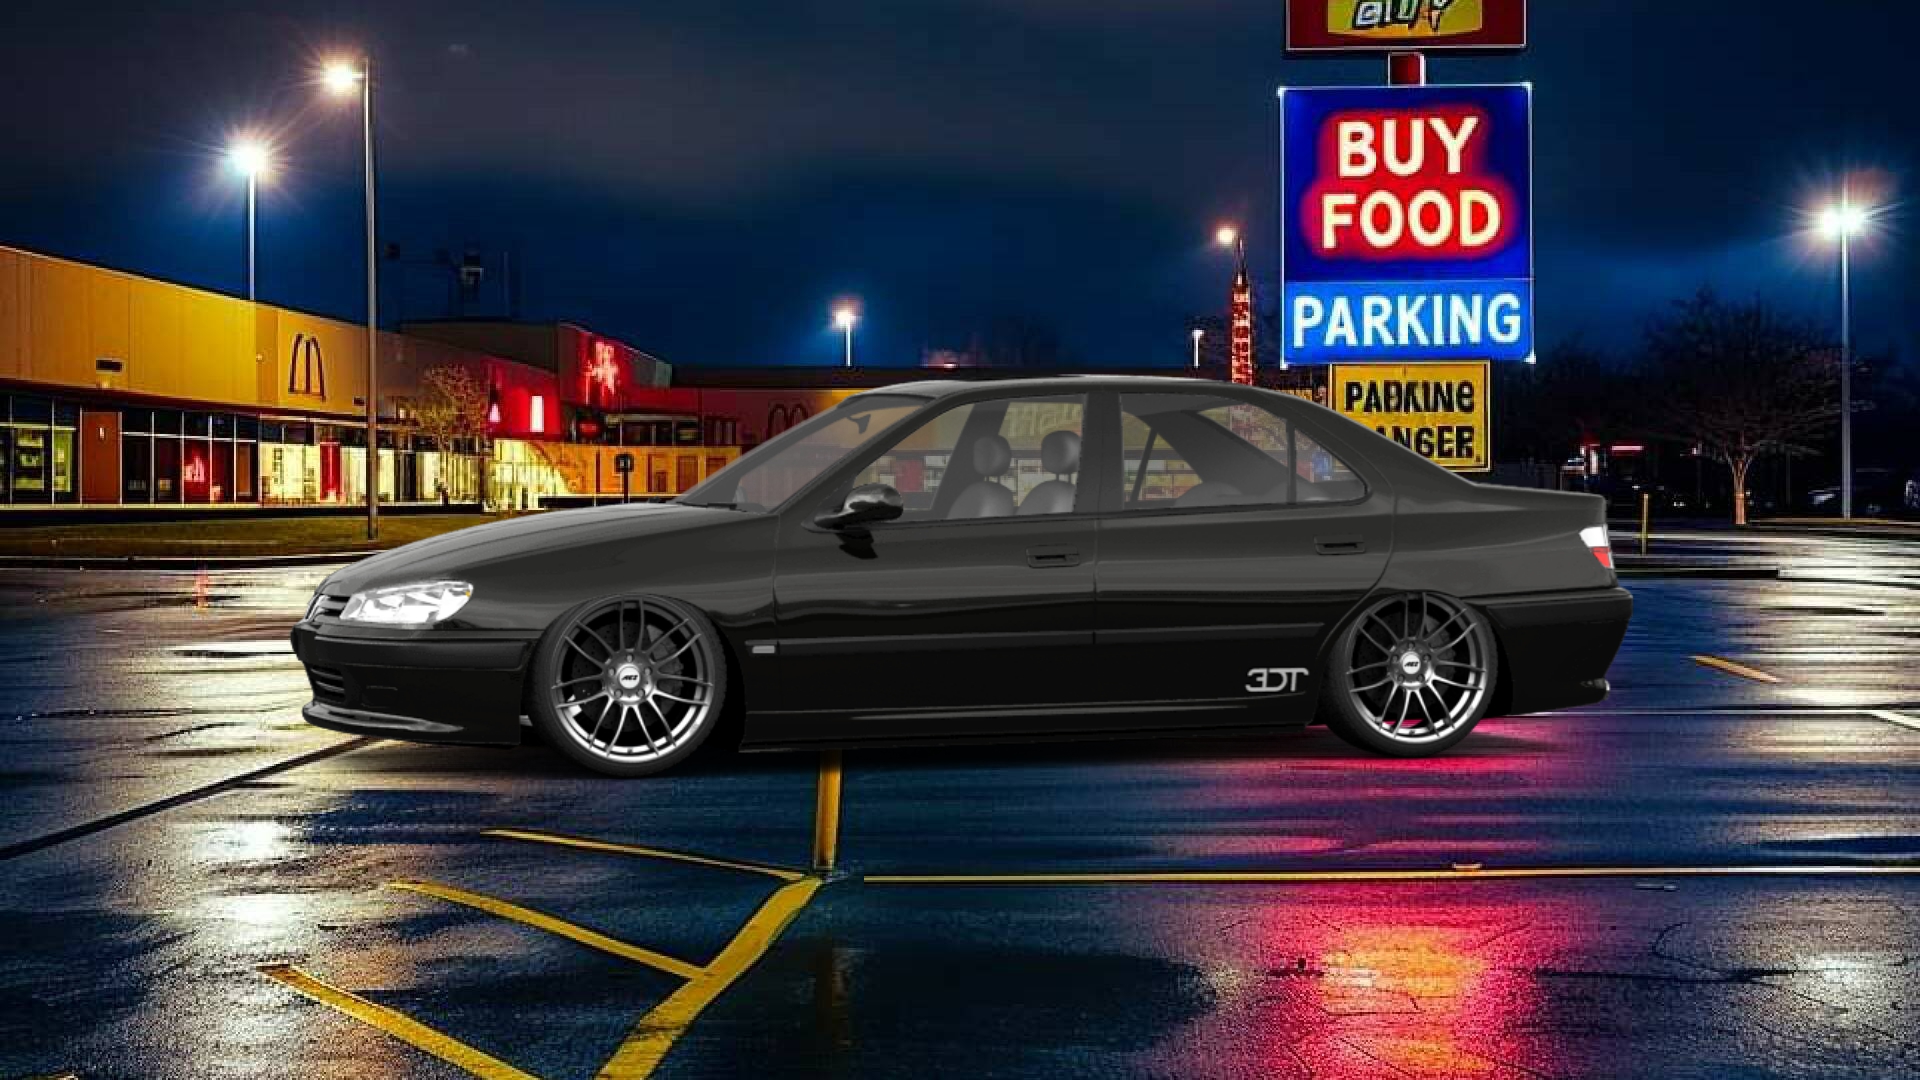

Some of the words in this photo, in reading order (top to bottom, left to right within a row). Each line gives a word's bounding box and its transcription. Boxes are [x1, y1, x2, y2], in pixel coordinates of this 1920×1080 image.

[1337, 116, 1478, 177] BUY
[1322, 189, 1501, 249] FOOD
[1293, 293, 1521, 348] PARKING
[1245, 667, 1309, 692] 3DT
